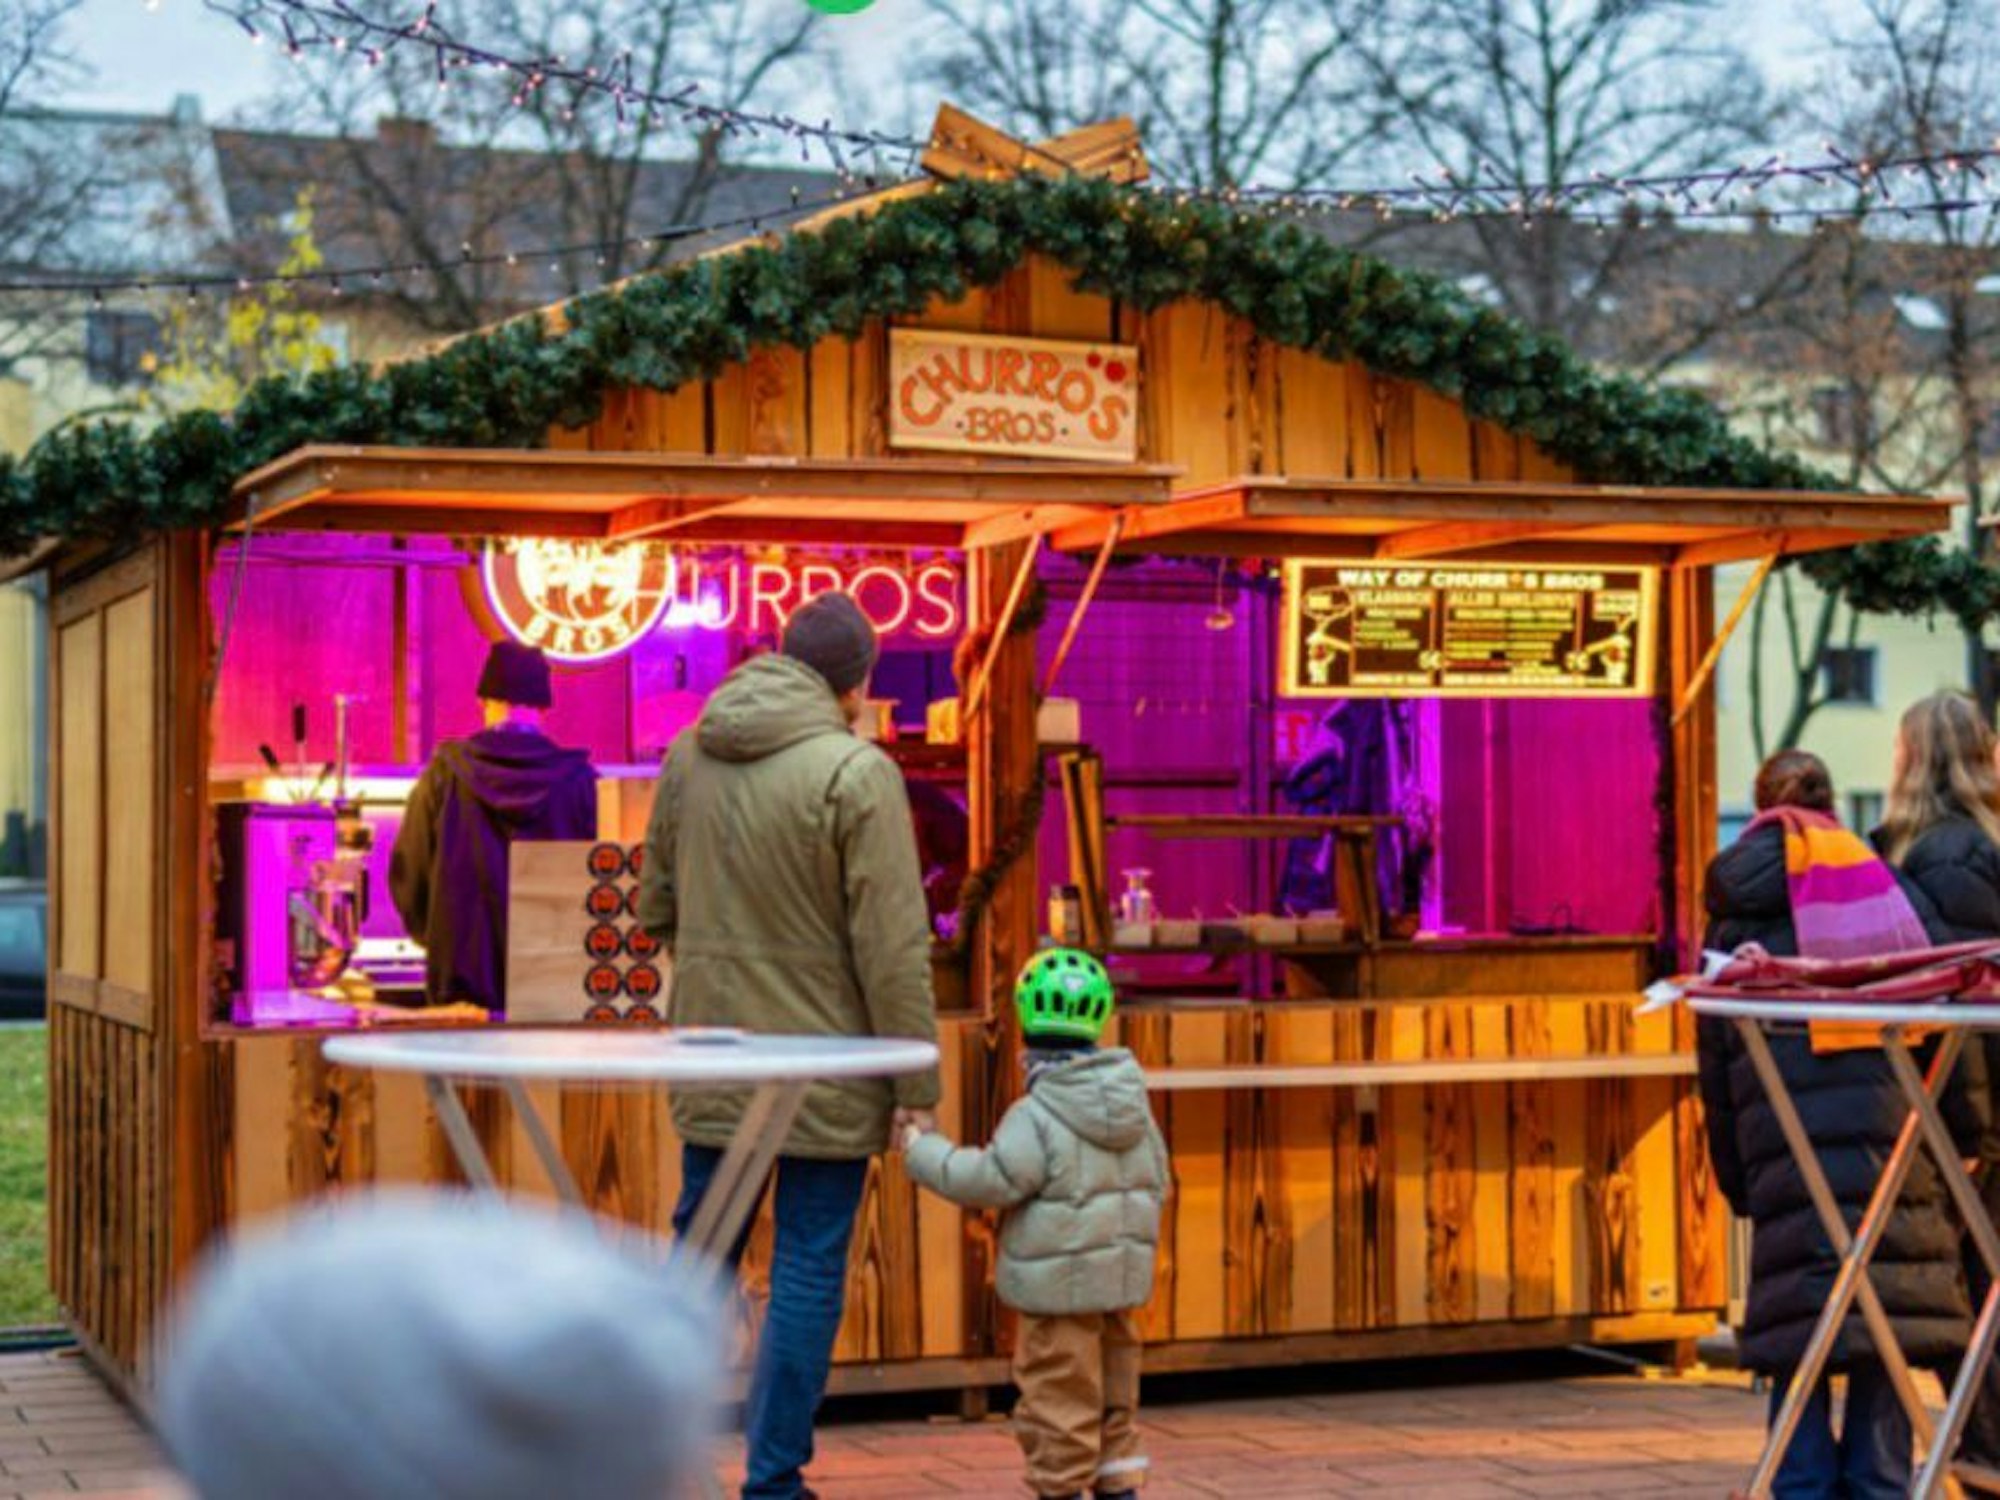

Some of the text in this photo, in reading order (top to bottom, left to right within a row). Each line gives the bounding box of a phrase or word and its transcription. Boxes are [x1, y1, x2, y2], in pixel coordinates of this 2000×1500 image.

[964, 406, 1055, 443] BROS
[1337, 569, 1391, 587] WAY
[1394, 570, 1427, 588] OF
[1542, 573, 1605, 591] BROS
[523, 611, 632, 652] BROS
